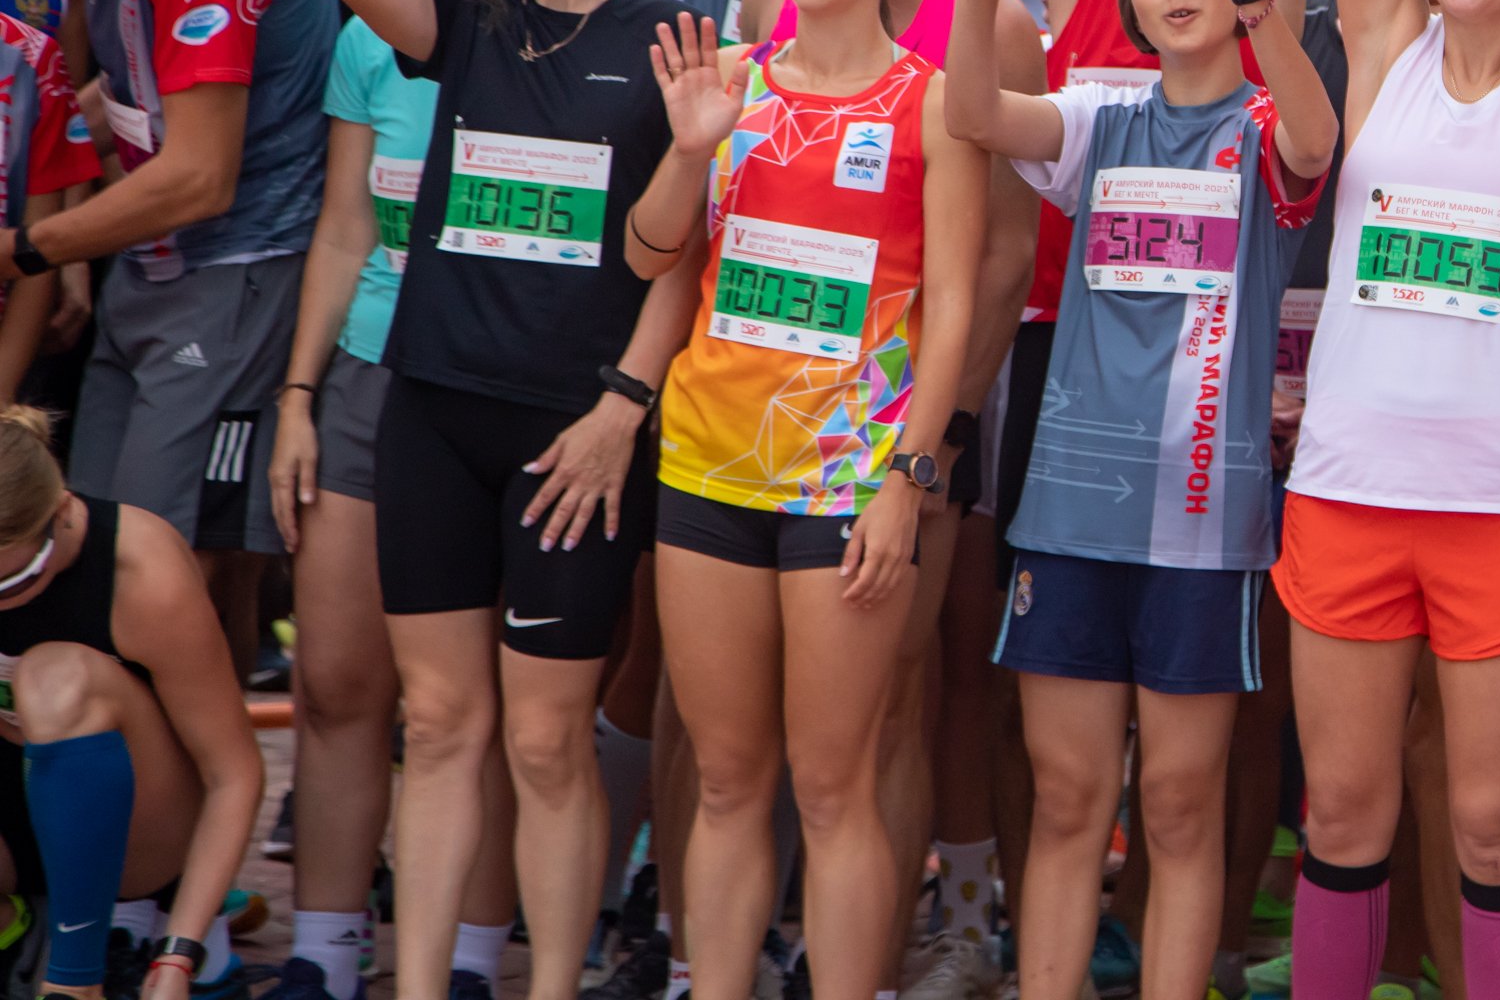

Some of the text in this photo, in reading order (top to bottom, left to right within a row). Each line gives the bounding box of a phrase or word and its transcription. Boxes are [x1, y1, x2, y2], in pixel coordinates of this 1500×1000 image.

[844, 155, 881, 170] AMUR
[847, 167, 874, 180] RUN
[1103, 180, 1229, 197] V АМУРСКИЙ МАРАФОН 2023
[466, 182, 574, 235] 10136
[1379, 195, 1393, 212] V
[1398, 197, 1447, 209] АМУРСКИЙ
[1450, 203, 1493, 215] МАРАФОН
[1422, 209, 1451, 220] МЕЧТЕ
[1108, 217, 1204, 264] 5124
[725, 268, 849, 329] 10033
[1186, 316, 1206, 358] 2023
[1185, 352, 1222, 515] МАРАФОН
